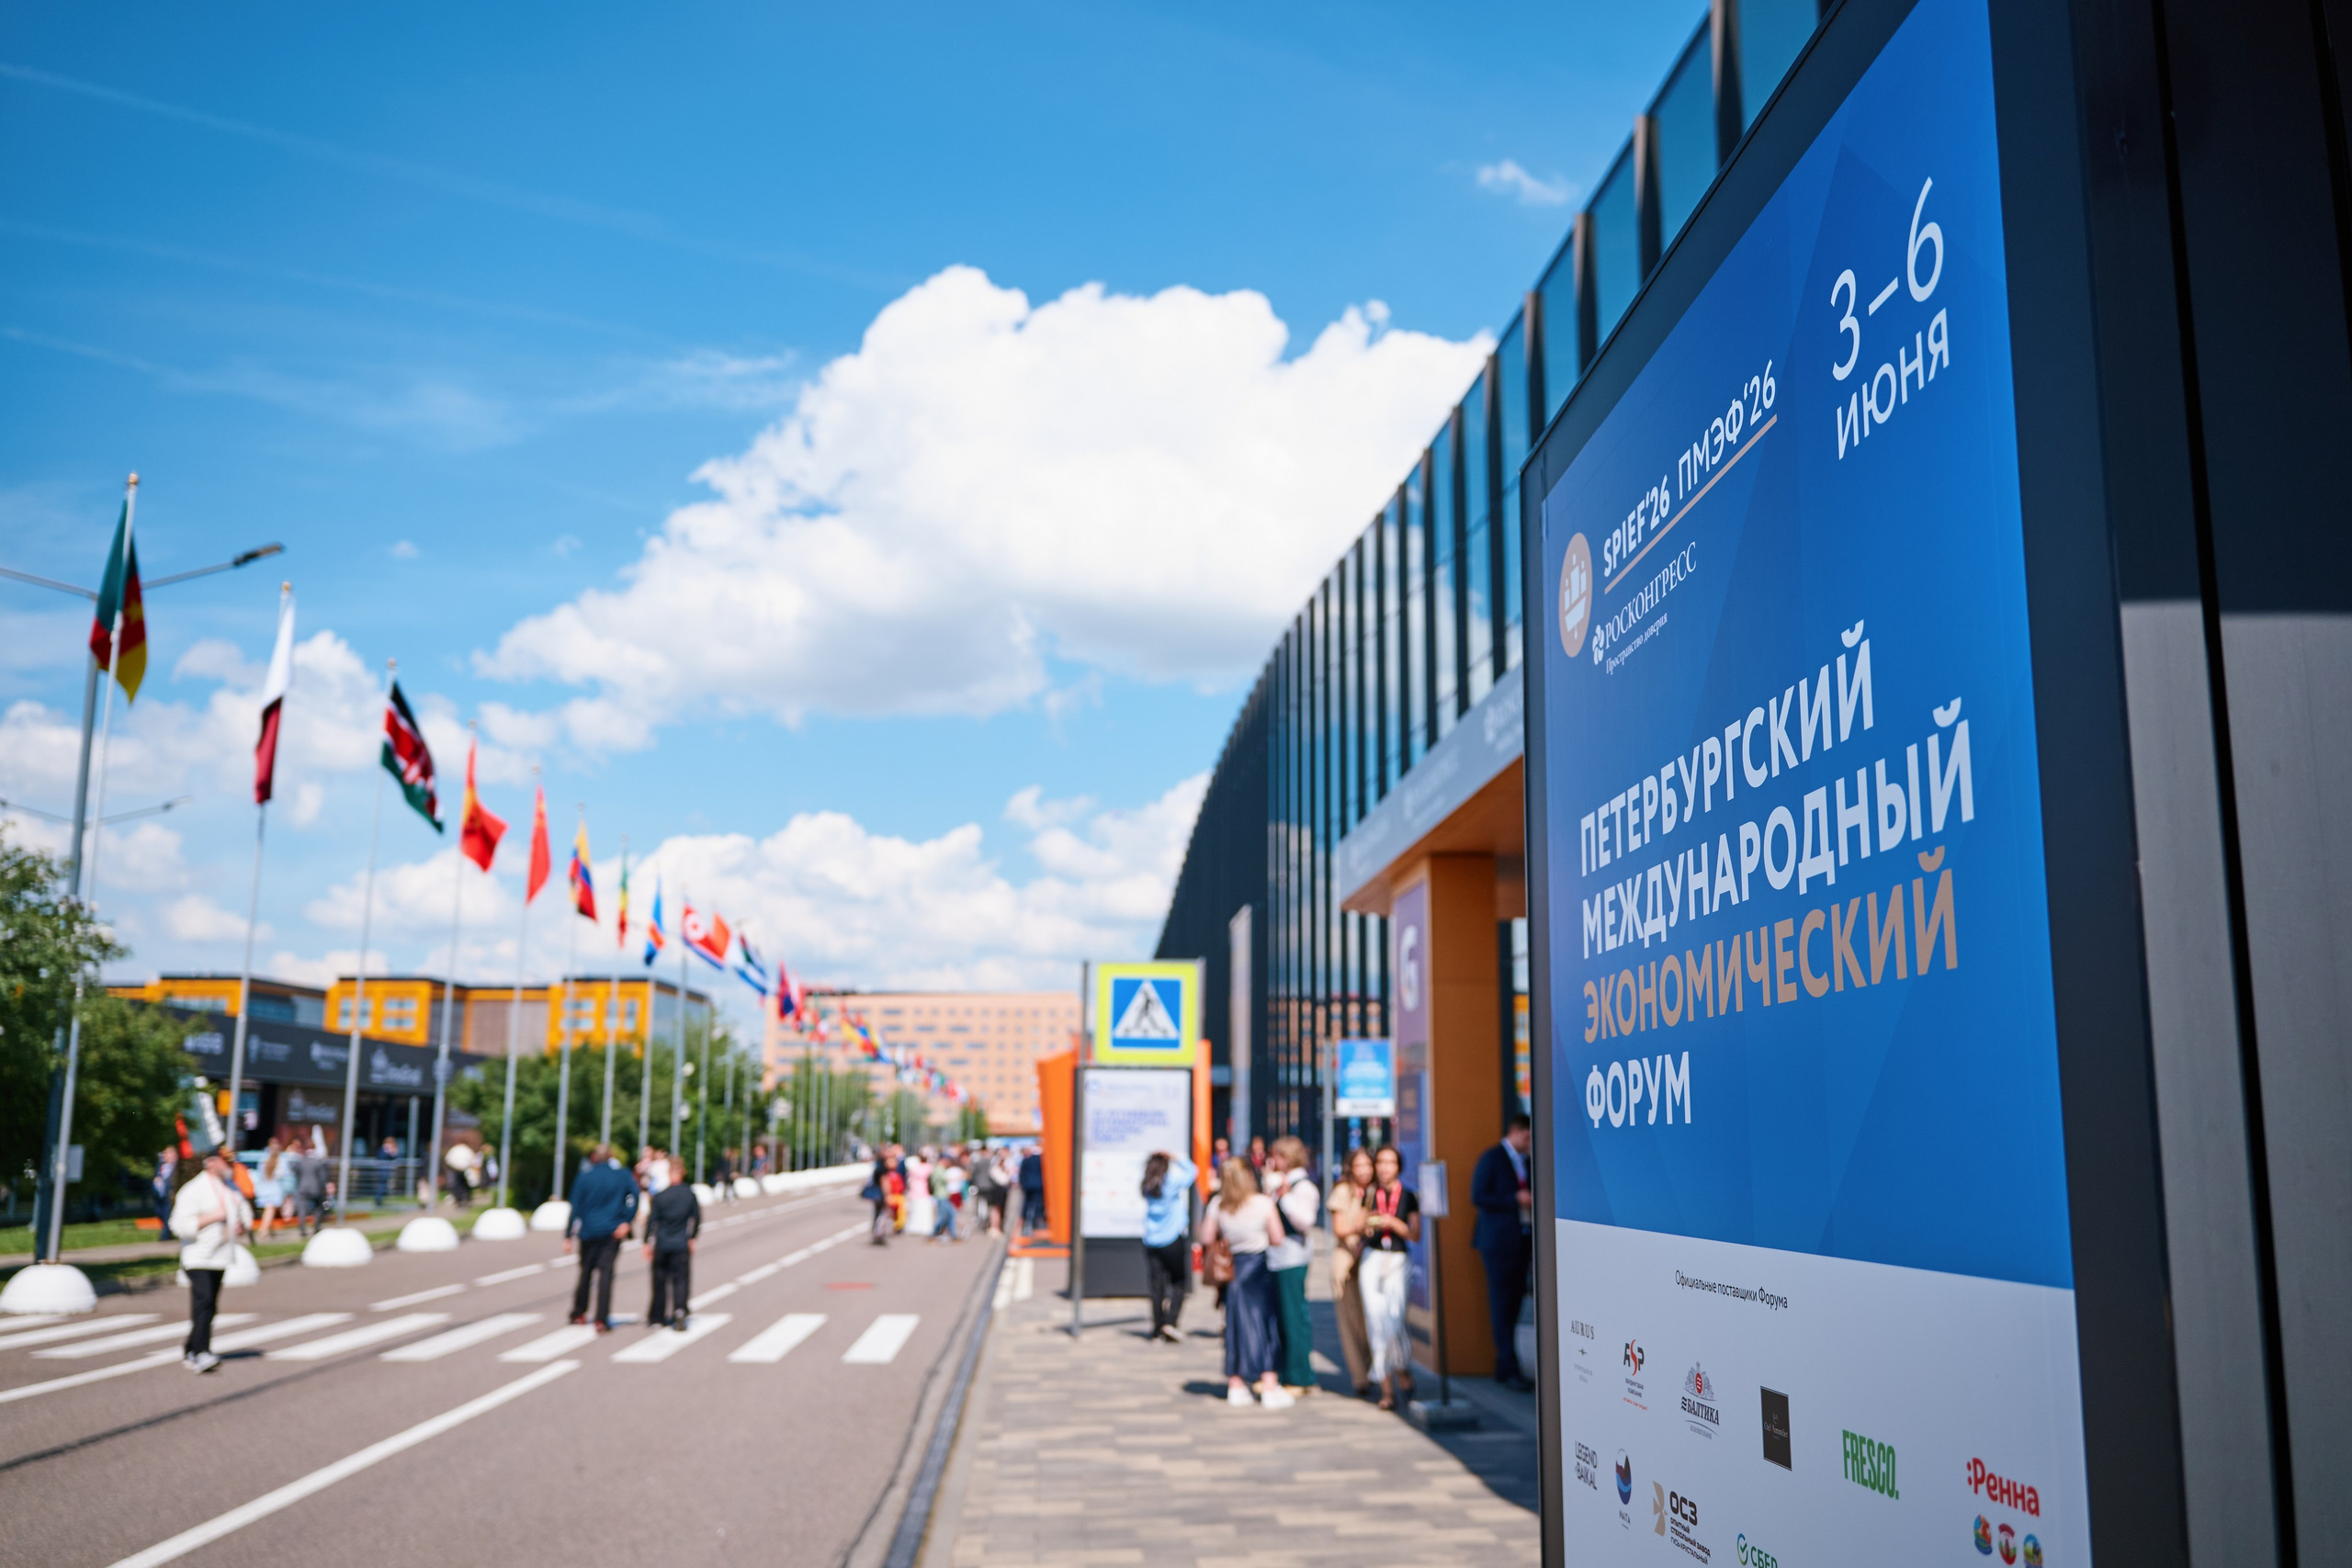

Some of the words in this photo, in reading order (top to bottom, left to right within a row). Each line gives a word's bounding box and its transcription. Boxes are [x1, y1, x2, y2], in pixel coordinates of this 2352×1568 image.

[1837, 307, 1951, 460] ИЮНЯ
[1605, 541, 1697, 650] РОСКОНГРЕСС
[1605, 634, 1644, 675] Пространство
[1644, 613, 1668, 645] доверия
[1580, 619, 1874, 877] ПЕТЕРБУРГСКИЙ
[1582, 695, 1975, 960] МЕЖДУНАРОДНЫЙ
[1583, 844, 1958, 1043] ЭКОНОМИЧЕСКИЙ
[1586, 1051, 1691, 1129] ФОРУМ
[1675, 1269, 1717, 1291] Официальные
[1717, 1283, 1758, 1303] поставщики
[1758, 1286, 1788, 1311] Форума
[1570, 1319, 1595, 1340] AURUS
[1687, 1397, 1720, 1426] БАЛТИКА
[1575, 1440, 1598, 1470] LEGEND
[1842, 1429, 1899, 1500] FRESCO.
